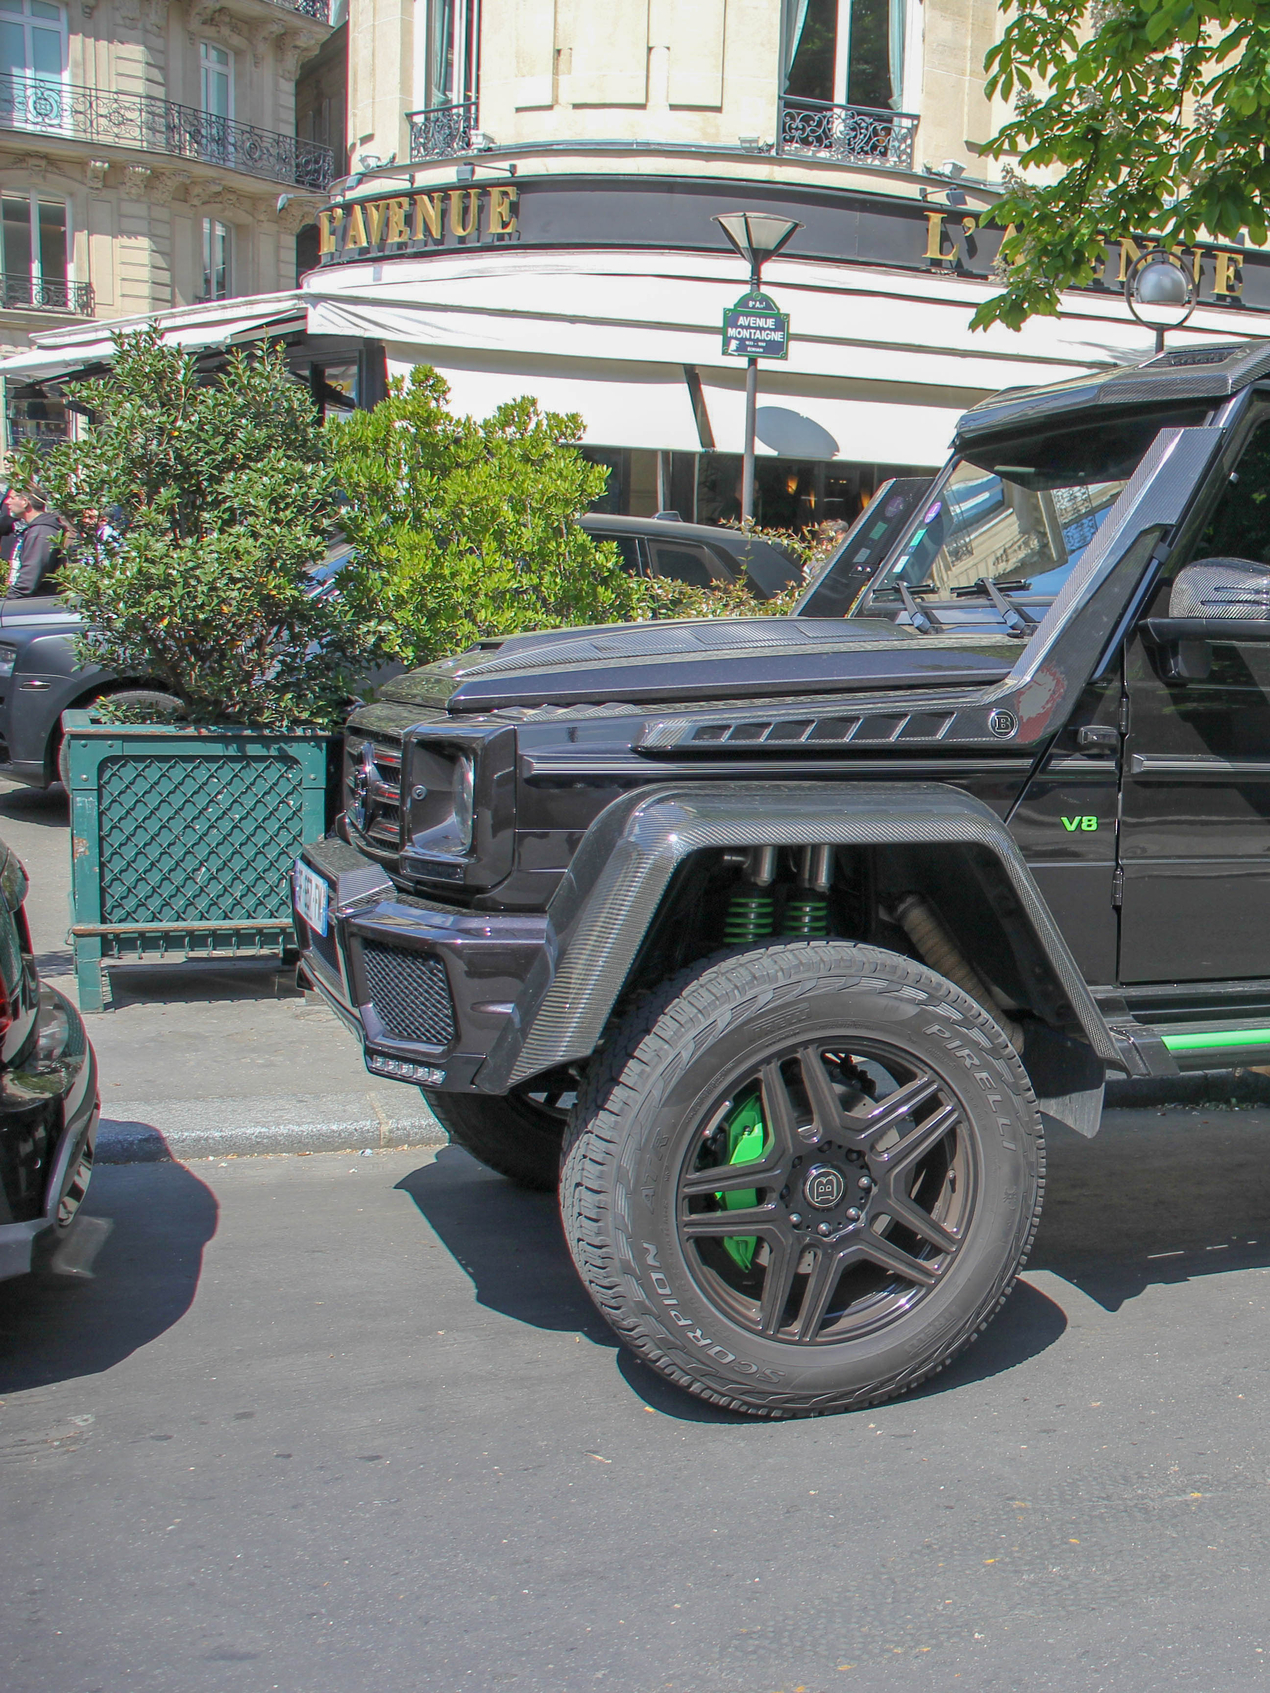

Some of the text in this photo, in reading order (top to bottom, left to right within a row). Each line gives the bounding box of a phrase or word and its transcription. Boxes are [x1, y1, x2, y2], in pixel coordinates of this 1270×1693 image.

[319, 187, 518, 256] L'AVENUE
[922, 211, 1244, 296] L'ANUE
[727, 328, 784, 341] MONTAIGNE
[737, 316, 776, 329] AVENUE
[1060, 815, 1099, 832] V8
[922, 1022, 1018, 1152] PIRELLI
[641, 1241, 787, 1385] SCORPION
